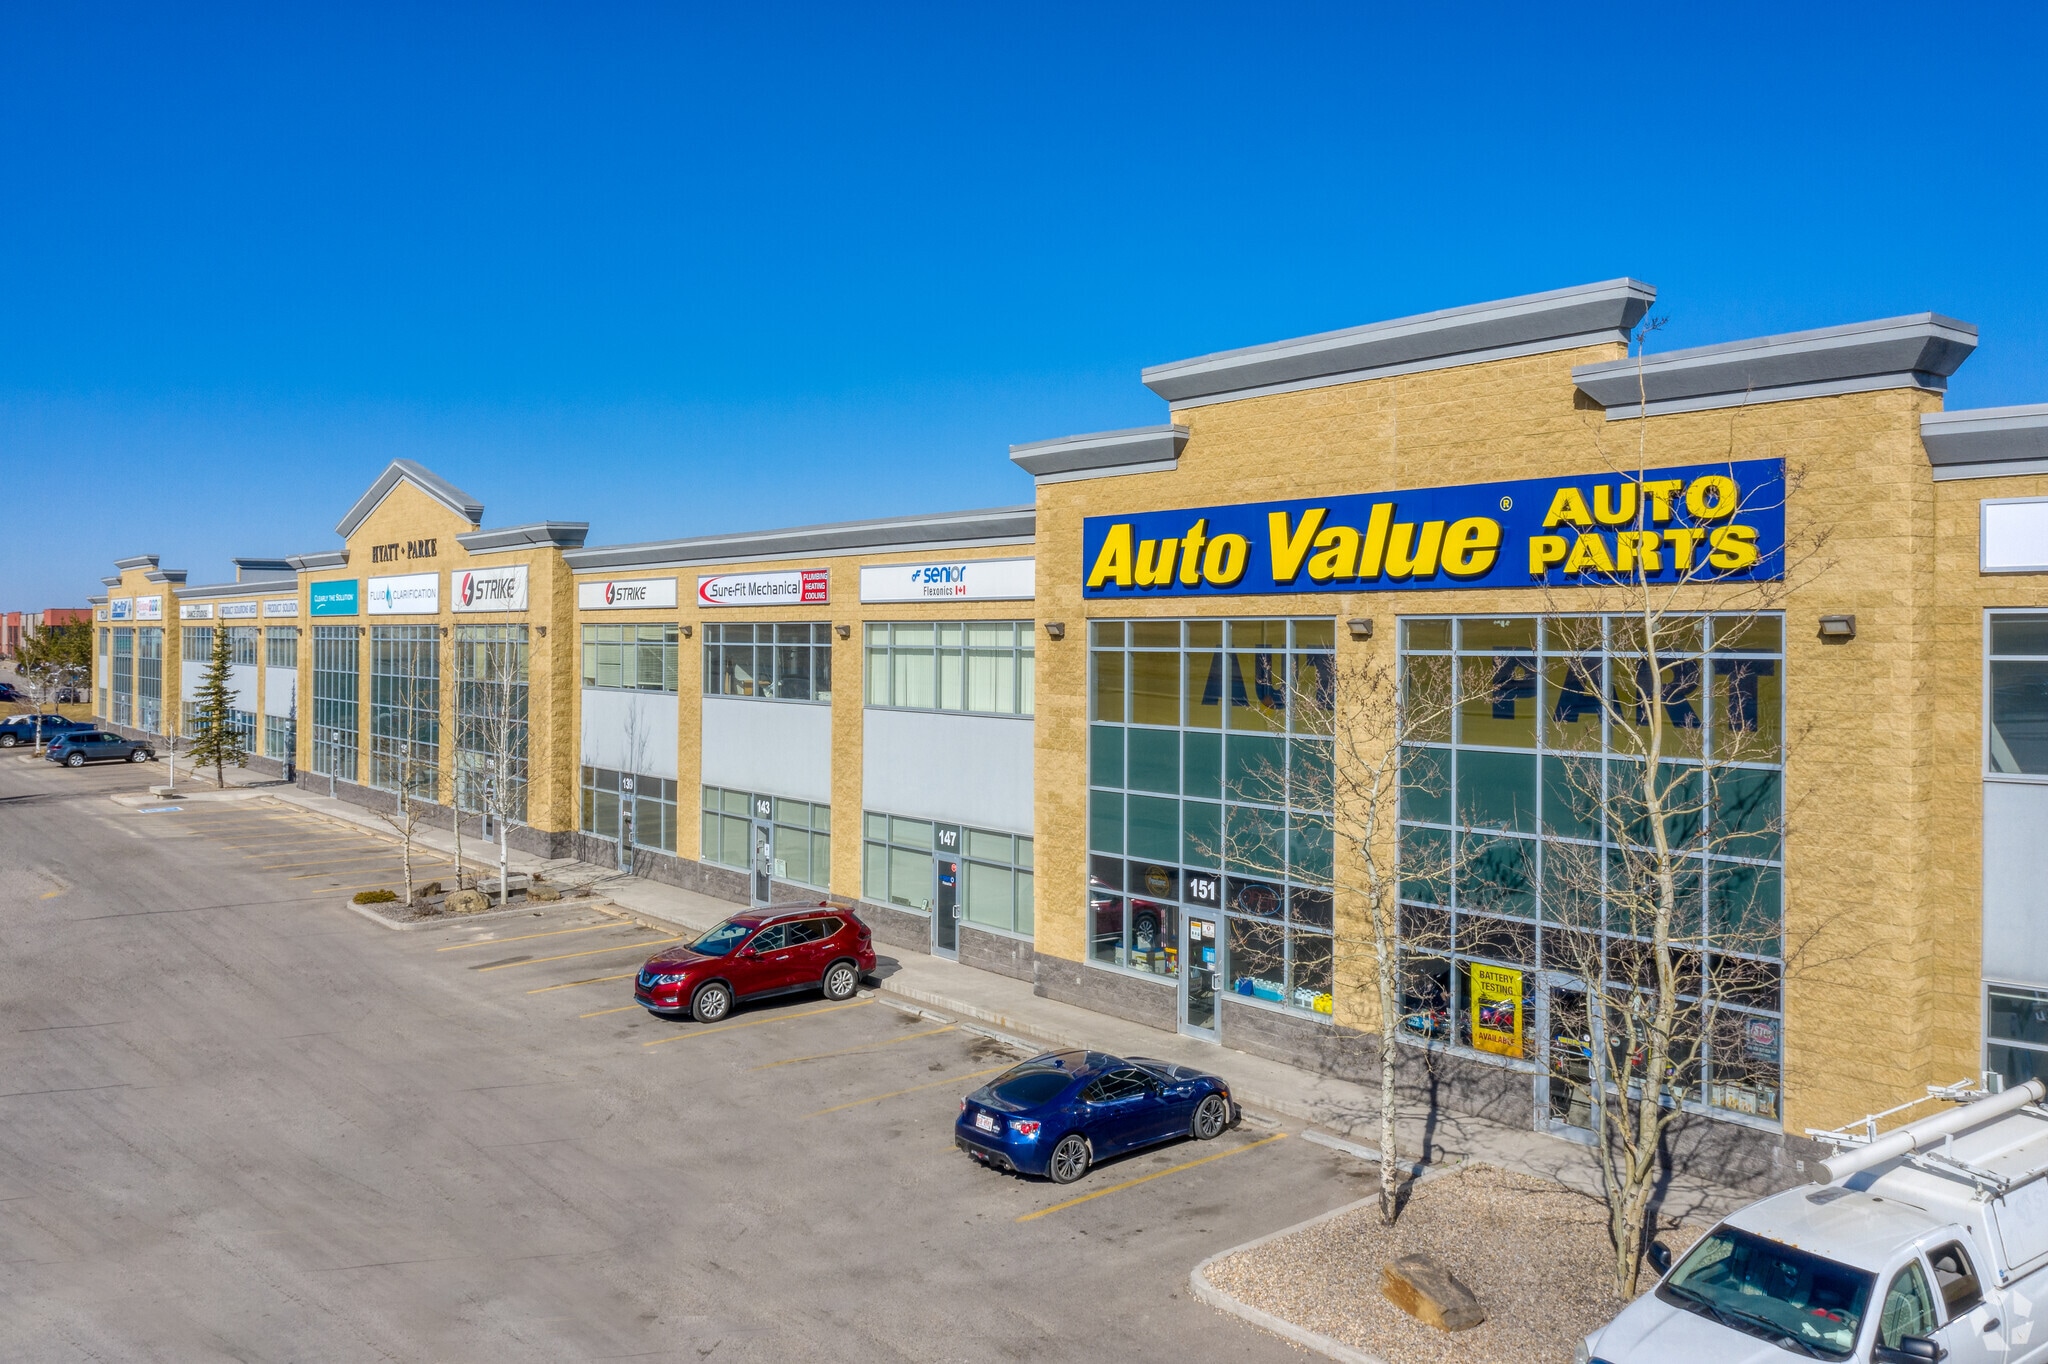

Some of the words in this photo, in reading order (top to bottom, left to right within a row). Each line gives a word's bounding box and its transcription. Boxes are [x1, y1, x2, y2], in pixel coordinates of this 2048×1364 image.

[1541, 475, 1739, 528] AUTO
[371, 543, 399, 564] HYATT
[406, 538, 438, 560] PARKE
[1086, 518, 1248, 589] Auto
[1268, 502, 1504, 583] Value
[1528, 524, 1760, 575] PARTS
[803, 571, 828, 581] PLUMBING
[923, 565, 967, 584] senior
[475, 577, 516, 600] STRIKE
[616, 586, 646, 601] STRIKE
[709, 582, 746, 598] Sure-Fit
[748, 580, 801, 596] Mechanical
[804, 582, 826, 590] HEATING
[923, 586, 953, 596] Flexonics
[369, 590, 386, 601] FLUID
[392, 588, 437, 600] CLARIFICATION
[804, 591, 826, 600] COOLING
[622, 777, 634, 790] 139
[756, 799, 771, 815] 143
[938, 829, 957, 847] 147
[1189, 878, 1215, 901] 151
[1479, 970, 1514, 984] BATTERY
[1480, 981, 1514, 996] TESTING
[1478, 1031, 1515, 1047] AVAILABLE
